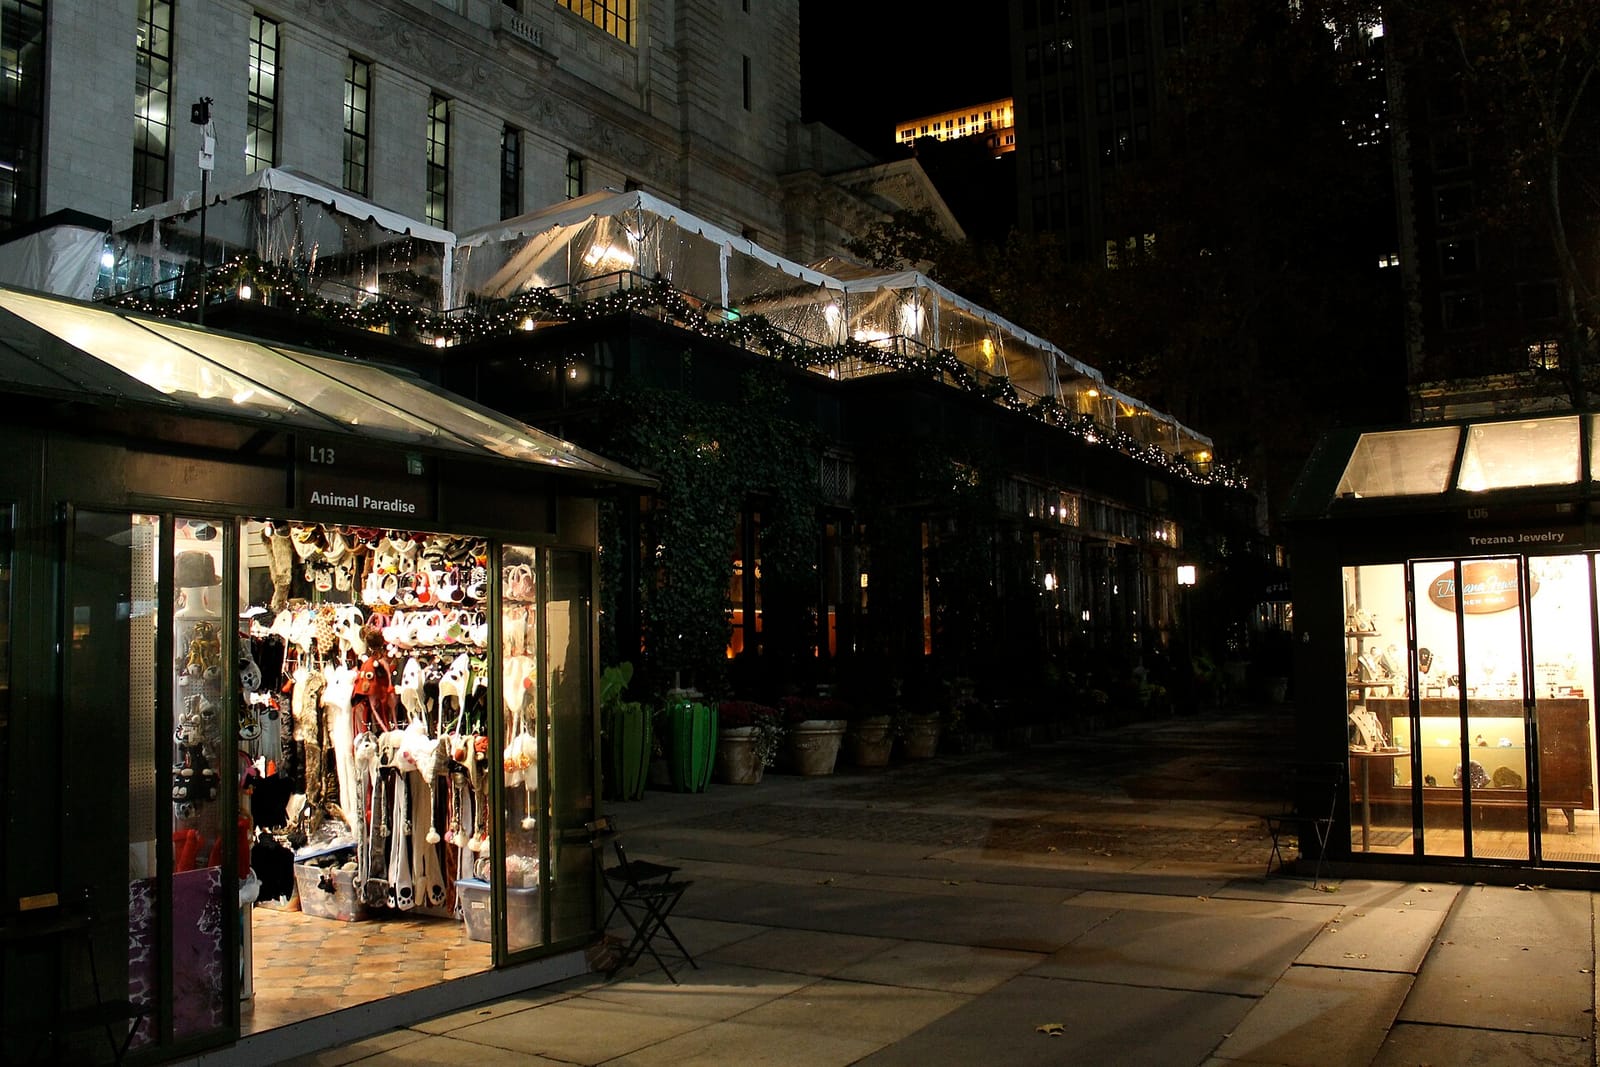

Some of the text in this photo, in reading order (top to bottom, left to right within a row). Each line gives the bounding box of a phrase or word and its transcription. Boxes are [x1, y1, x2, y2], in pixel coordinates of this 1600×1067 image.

[309, 445, 335, 465] L13
[310, 491, 416, 513] Animal Paradise
[1469, 531, 1565, 546] Trezana Jewelry
